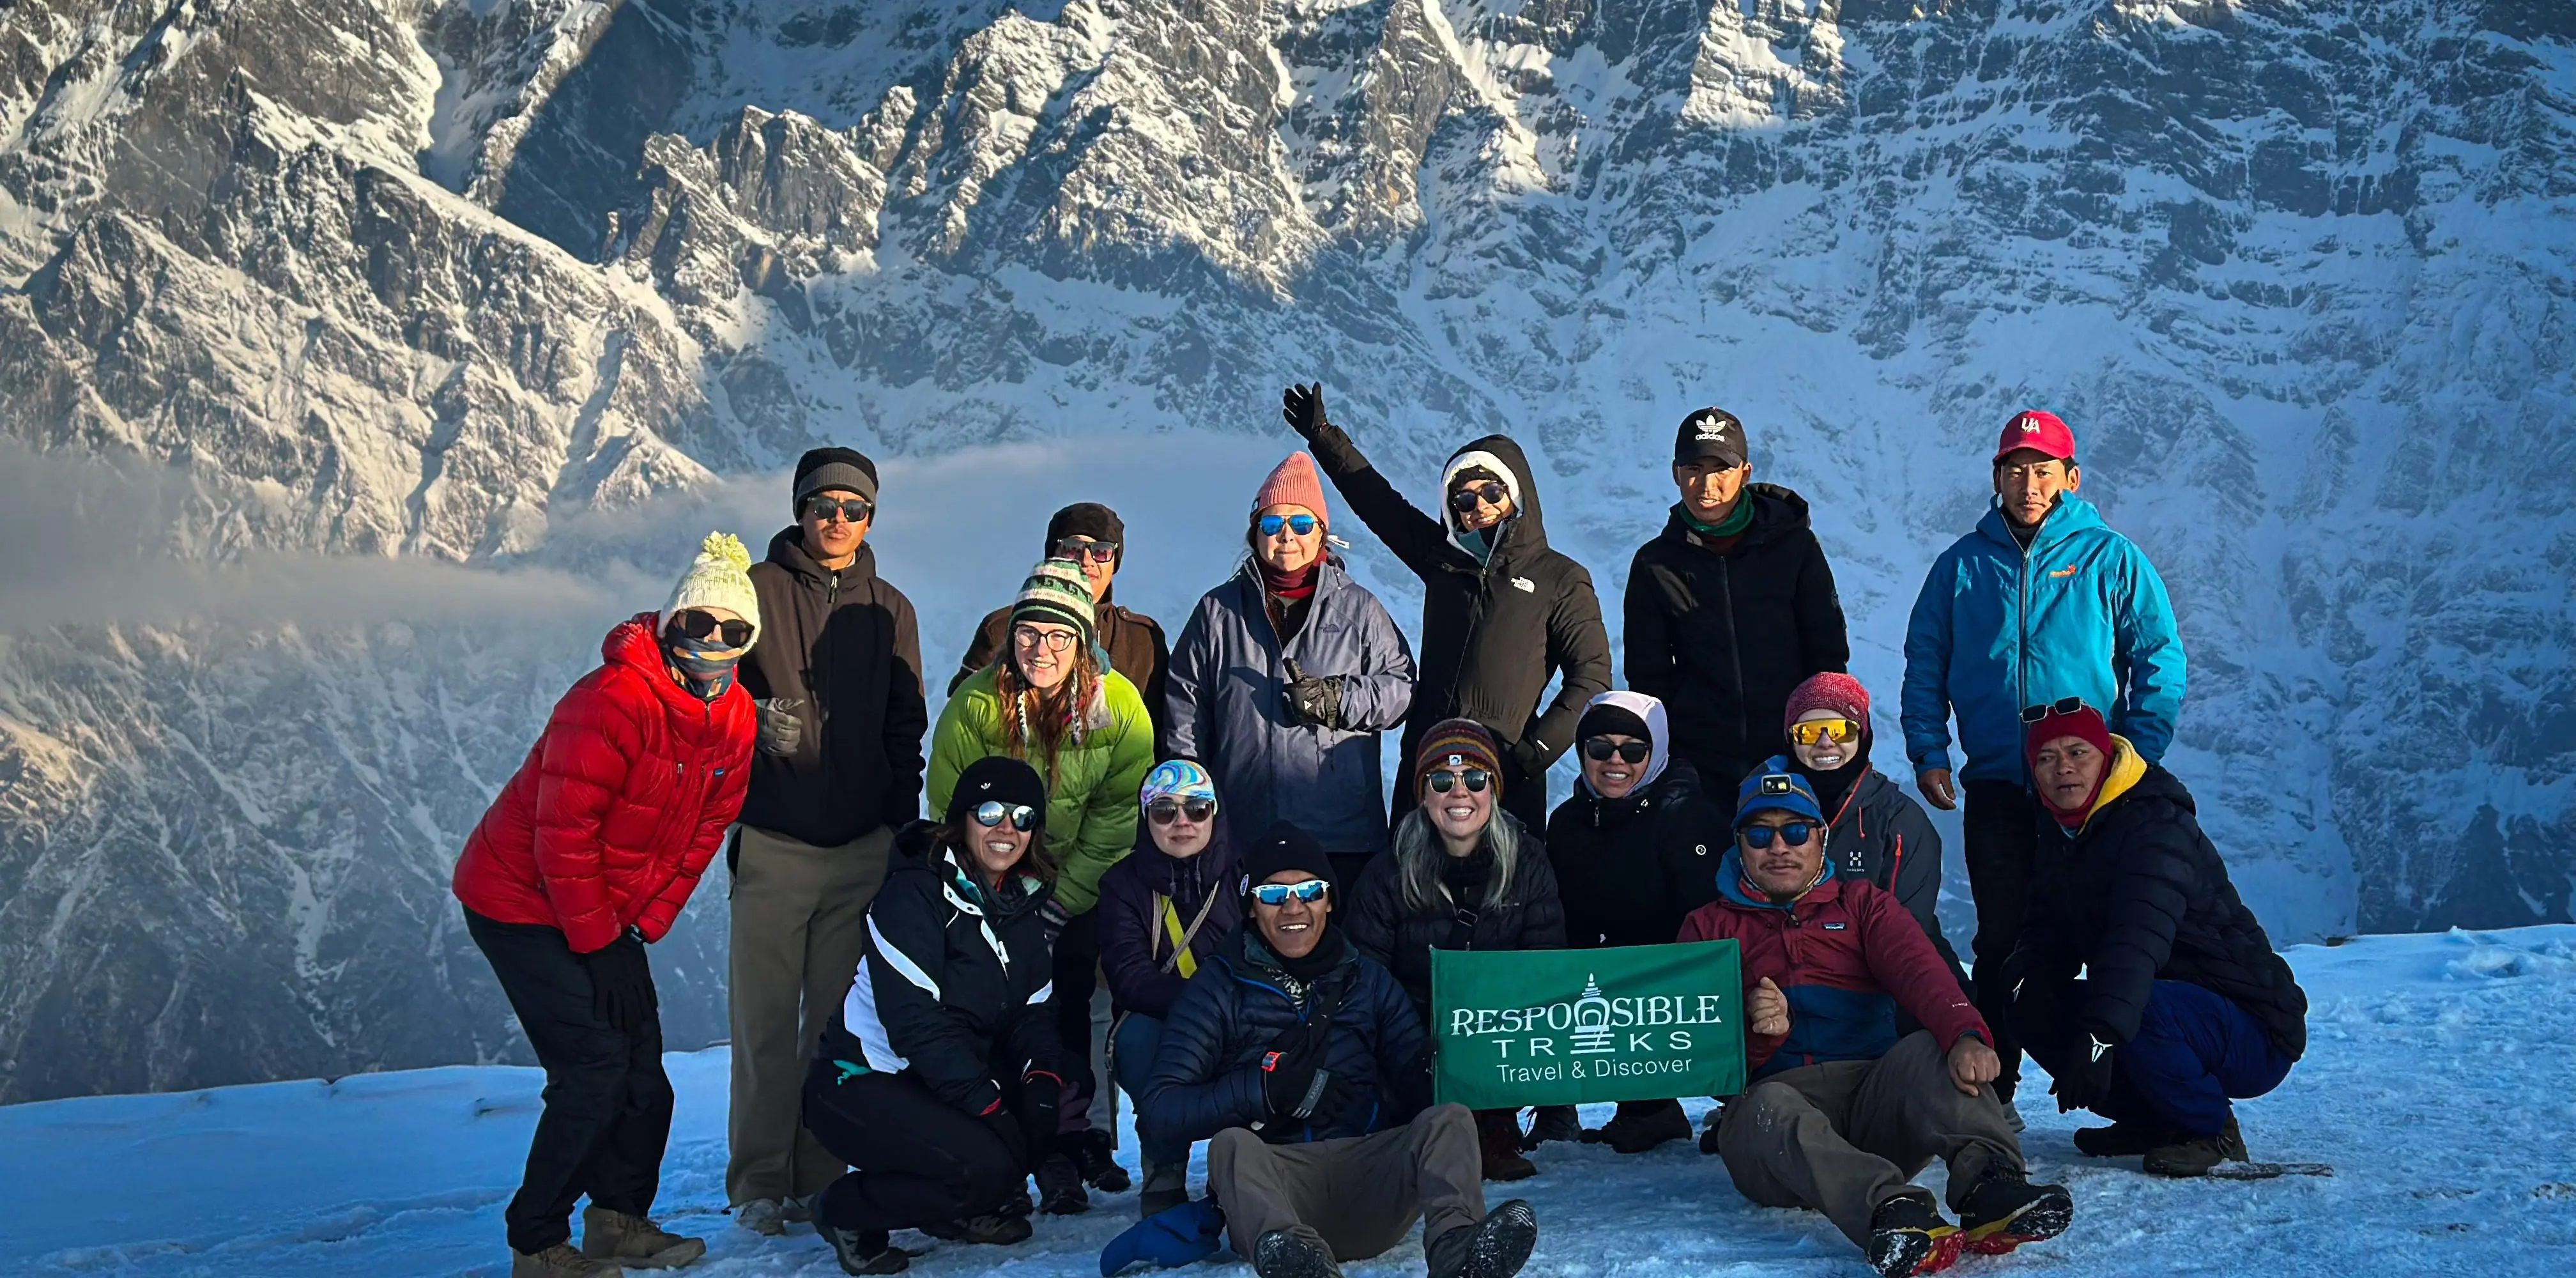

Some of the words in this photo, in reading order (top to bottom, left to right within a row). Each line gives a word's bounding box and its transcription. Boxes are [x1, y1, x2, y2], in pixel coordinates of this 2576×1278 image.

[1695, 432, 1725, 442] adidas
[1450, 995, 1722, 1037] RESPONSIBLE
[1492, 1031, 1692, 1058] TREKS
[1497, 1061, 1562, 1083] Travel
[1572, 1061, 1586, 1079] &
[1595, 1058, 1692, 1077] Discover
